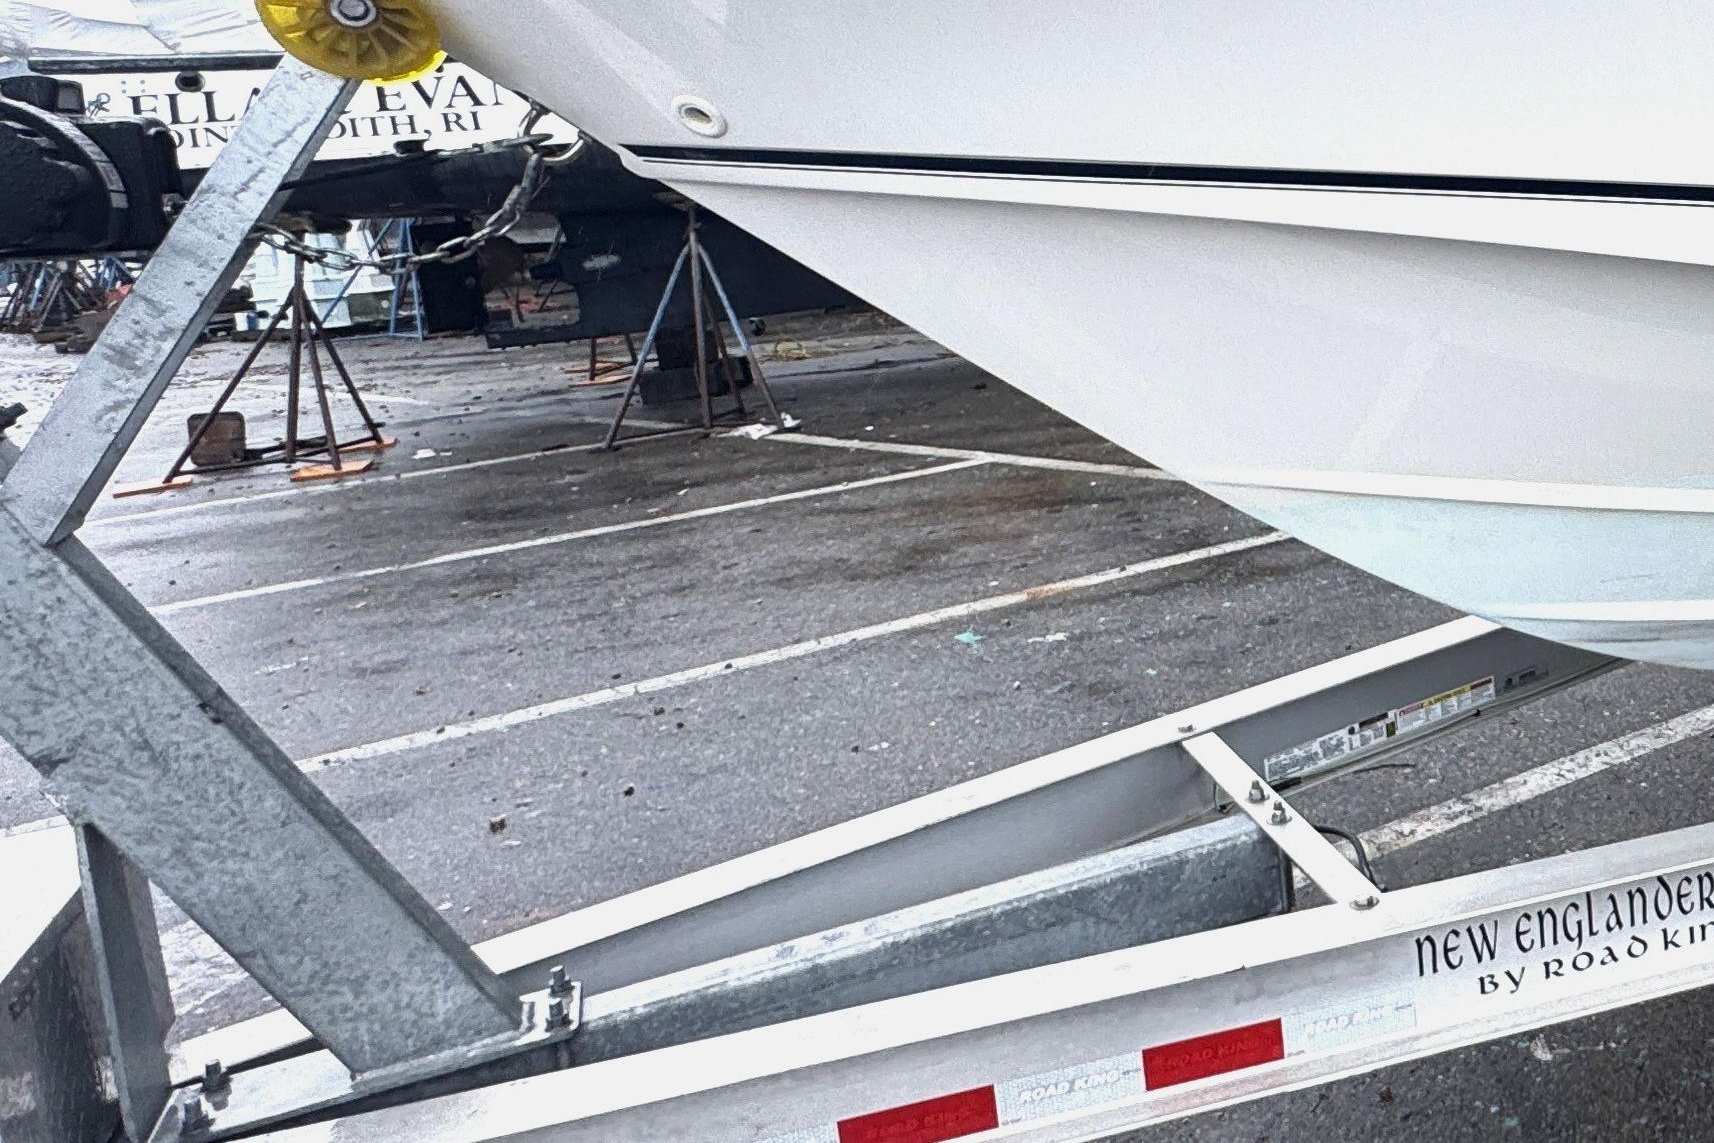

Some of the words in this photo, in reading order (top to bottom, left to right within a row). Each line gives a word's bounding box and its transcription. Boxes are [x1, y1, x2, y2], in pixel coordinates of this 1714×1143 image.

[376, 74, 504, 113] EVA
[441, 111, 482, 133] RI
[1415, 919, 1499, 977] NEW
[1477, 966, 1526, 994] BY
[1543, 934, 1649, 980] ROAD
[1019, 1081, 1071, 1105] ROAD
[1073, 1069, 1120, 1093] KING
